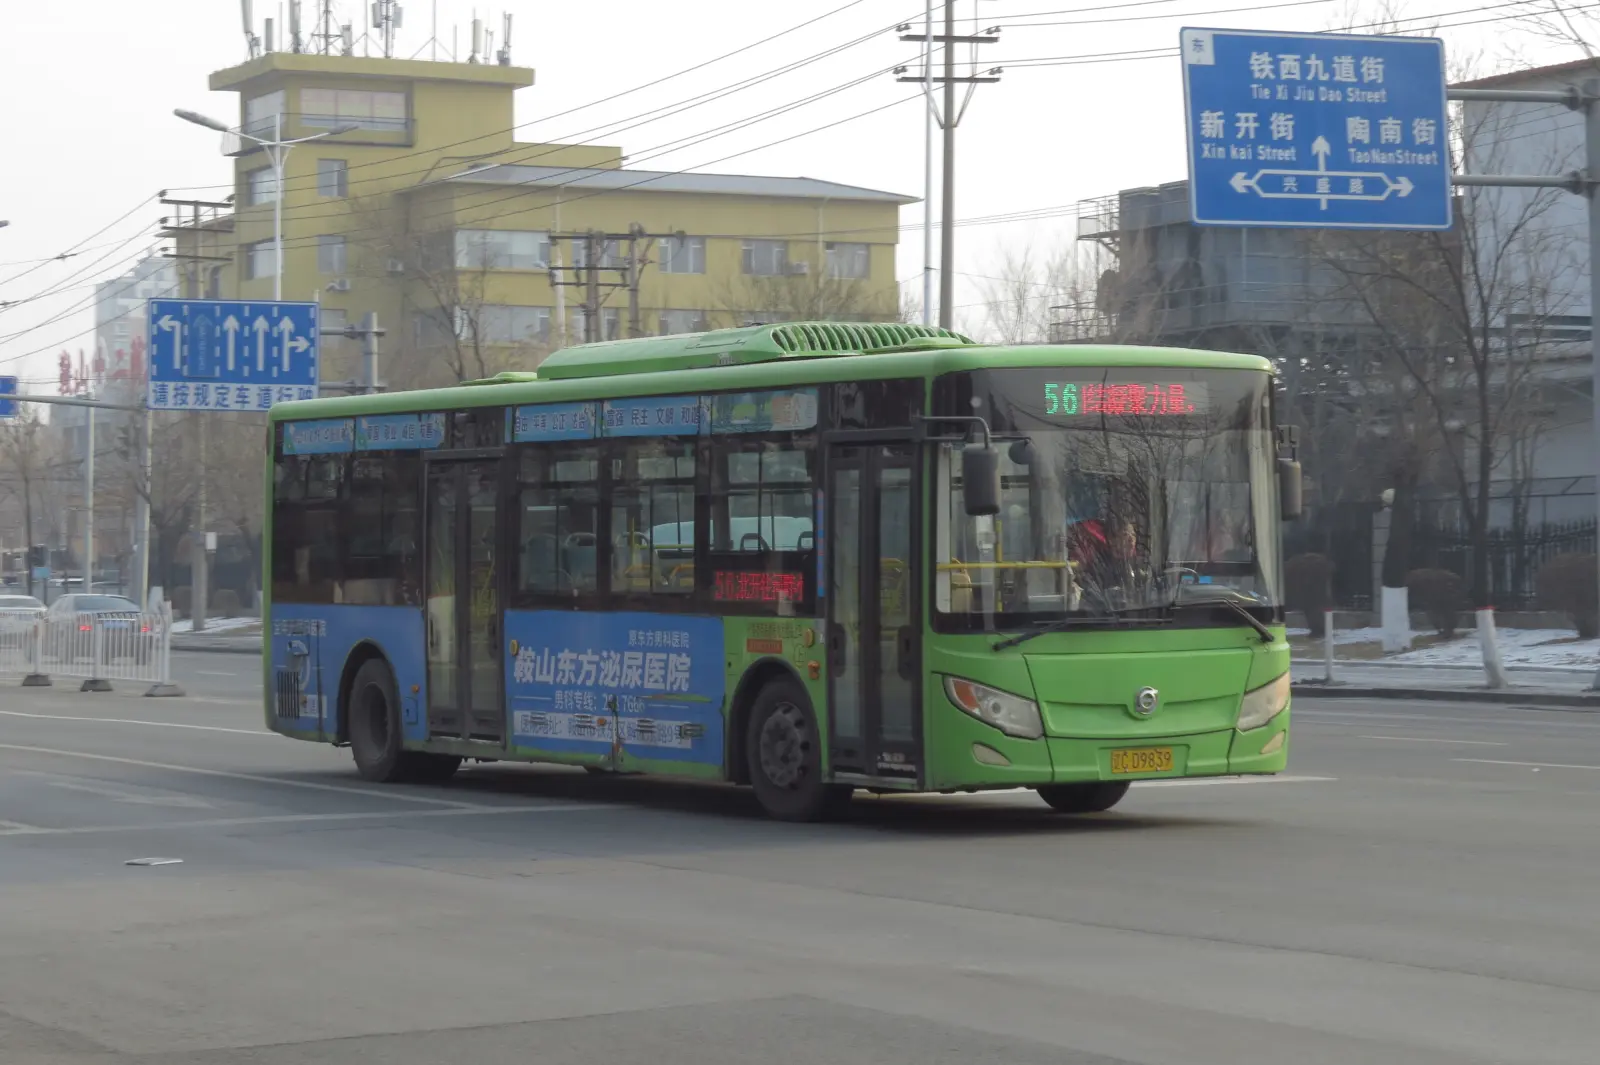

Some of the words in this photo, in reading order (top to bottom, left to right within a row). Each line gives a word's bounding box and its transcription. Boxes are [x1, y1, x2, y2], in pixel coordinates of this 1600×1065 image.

[1191, 37, 1206, 53] 东
[1249, 52, 1385, 84] 铁西九道街
[1250, 84, 1271, 100] Tie
[1275, 85, 1289, 101] Xi
[1293, 86, 1315, 102] Jiu
[1318, 87, 1342, 102] Dao
[1346, 87, 1388, 103] Street
[1200, 110, 1295, 141] 新开街
[1346, 116, 1437, 145] 陶南街
[1200, 143, 1226, 159] Xin
[1230, 144, 1253, 160] kai
[1256, 145, 1297, 161] Street
[1283, 176, 1365, 194] 兴盛路
[152, 384, 314, 409] 请按规定车道行驶
[1044, 383, 1078, 415] 56
[606, 408, 625, 427] 富强
[631, 408, 648, 426] 民主
[655, 408, 674, 425] 文明
[628, 630, 690, 649] 原东方男科医院
[513, 647, 691, 692] 鞍山东方泌尿医院
